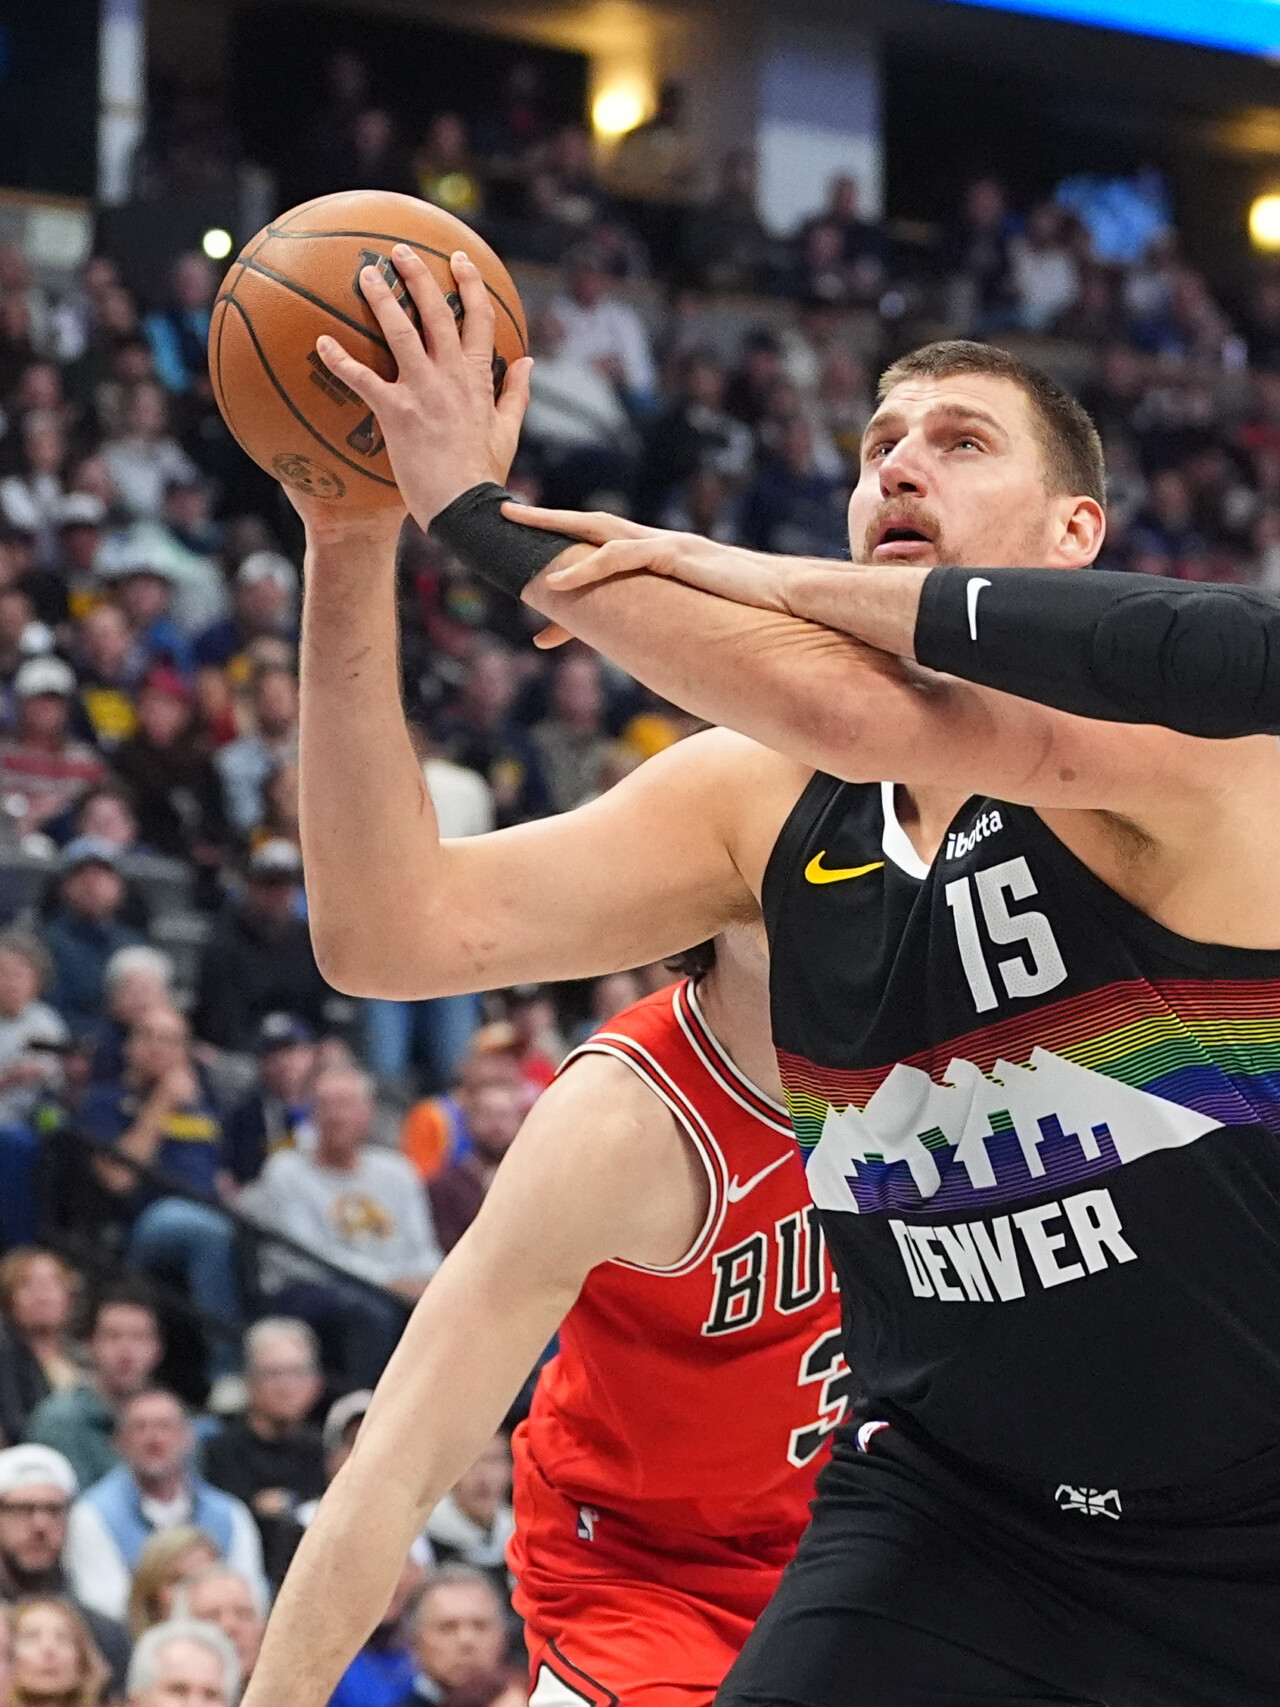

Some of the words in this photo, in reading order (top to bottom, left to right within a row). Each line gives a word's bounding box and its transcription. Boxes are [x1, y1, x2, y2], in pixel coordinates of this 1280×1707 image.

[945, 810, 1004, 860] ibotta
[945, 855, 1068, 1013] 15
[700, 1203, 841, 1337] BU
[888, 1188, 1138, 1303] DENVER
